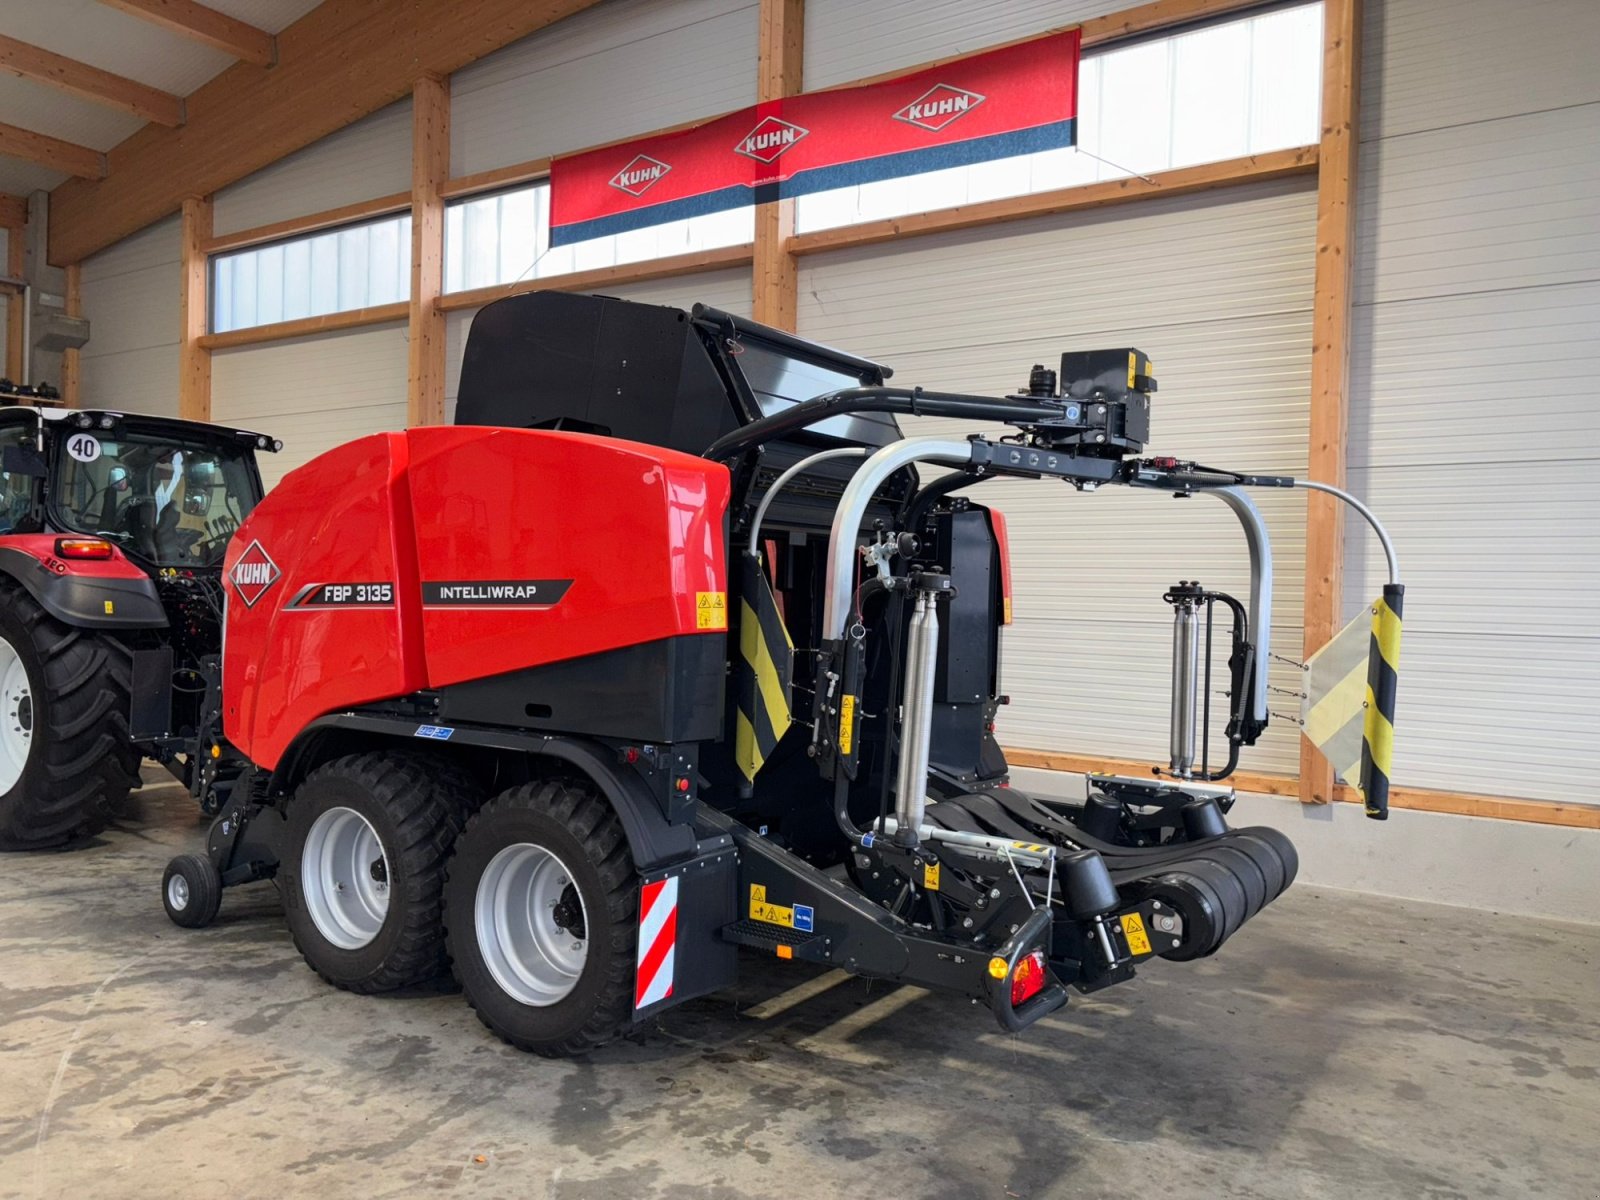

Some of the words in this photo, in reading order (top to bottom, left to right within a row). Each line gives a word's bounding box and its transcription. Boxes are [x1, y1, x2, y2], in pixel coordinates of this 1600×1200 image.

[909, 95, 969, 120] KUHN
[746, 128, 794, 153] KUHN
[621, 165, 661, 187] KUHN
[72, 438, 94, 457] 40
[236, 563, 271, 584] KUHN
[325, 585, 352, 602] FBP
[356, 585, 392, 601] 3135
[440, 586, 537, 599] INTELLIWRAP
